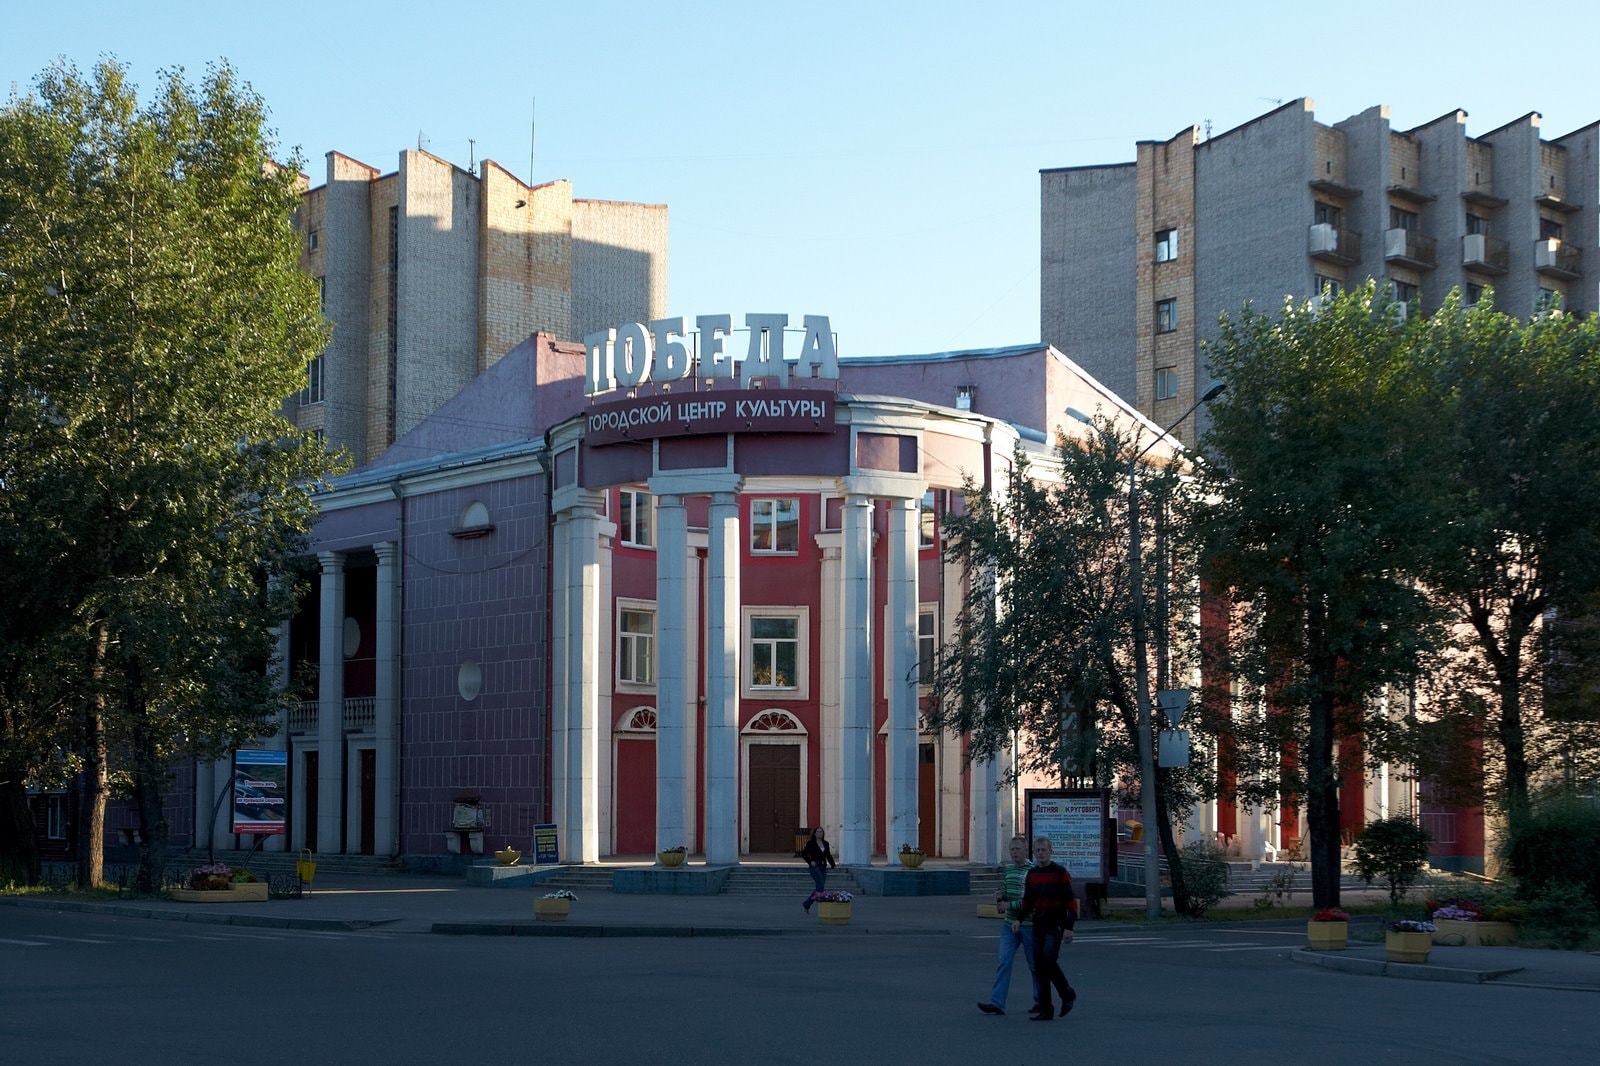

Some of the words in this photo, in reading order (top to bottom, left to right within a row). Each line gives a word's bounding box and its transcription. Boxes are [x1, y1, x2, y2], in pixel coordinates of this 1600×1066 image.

[584, 313, 839, 396] ПОБЕДА
[588, 401, 672, 433] ГОРОДСКОЙ
[677, 401, 726, 423] ЦЕНТР
[735, 399, 826, 418] КУЛЬТУРЫ
